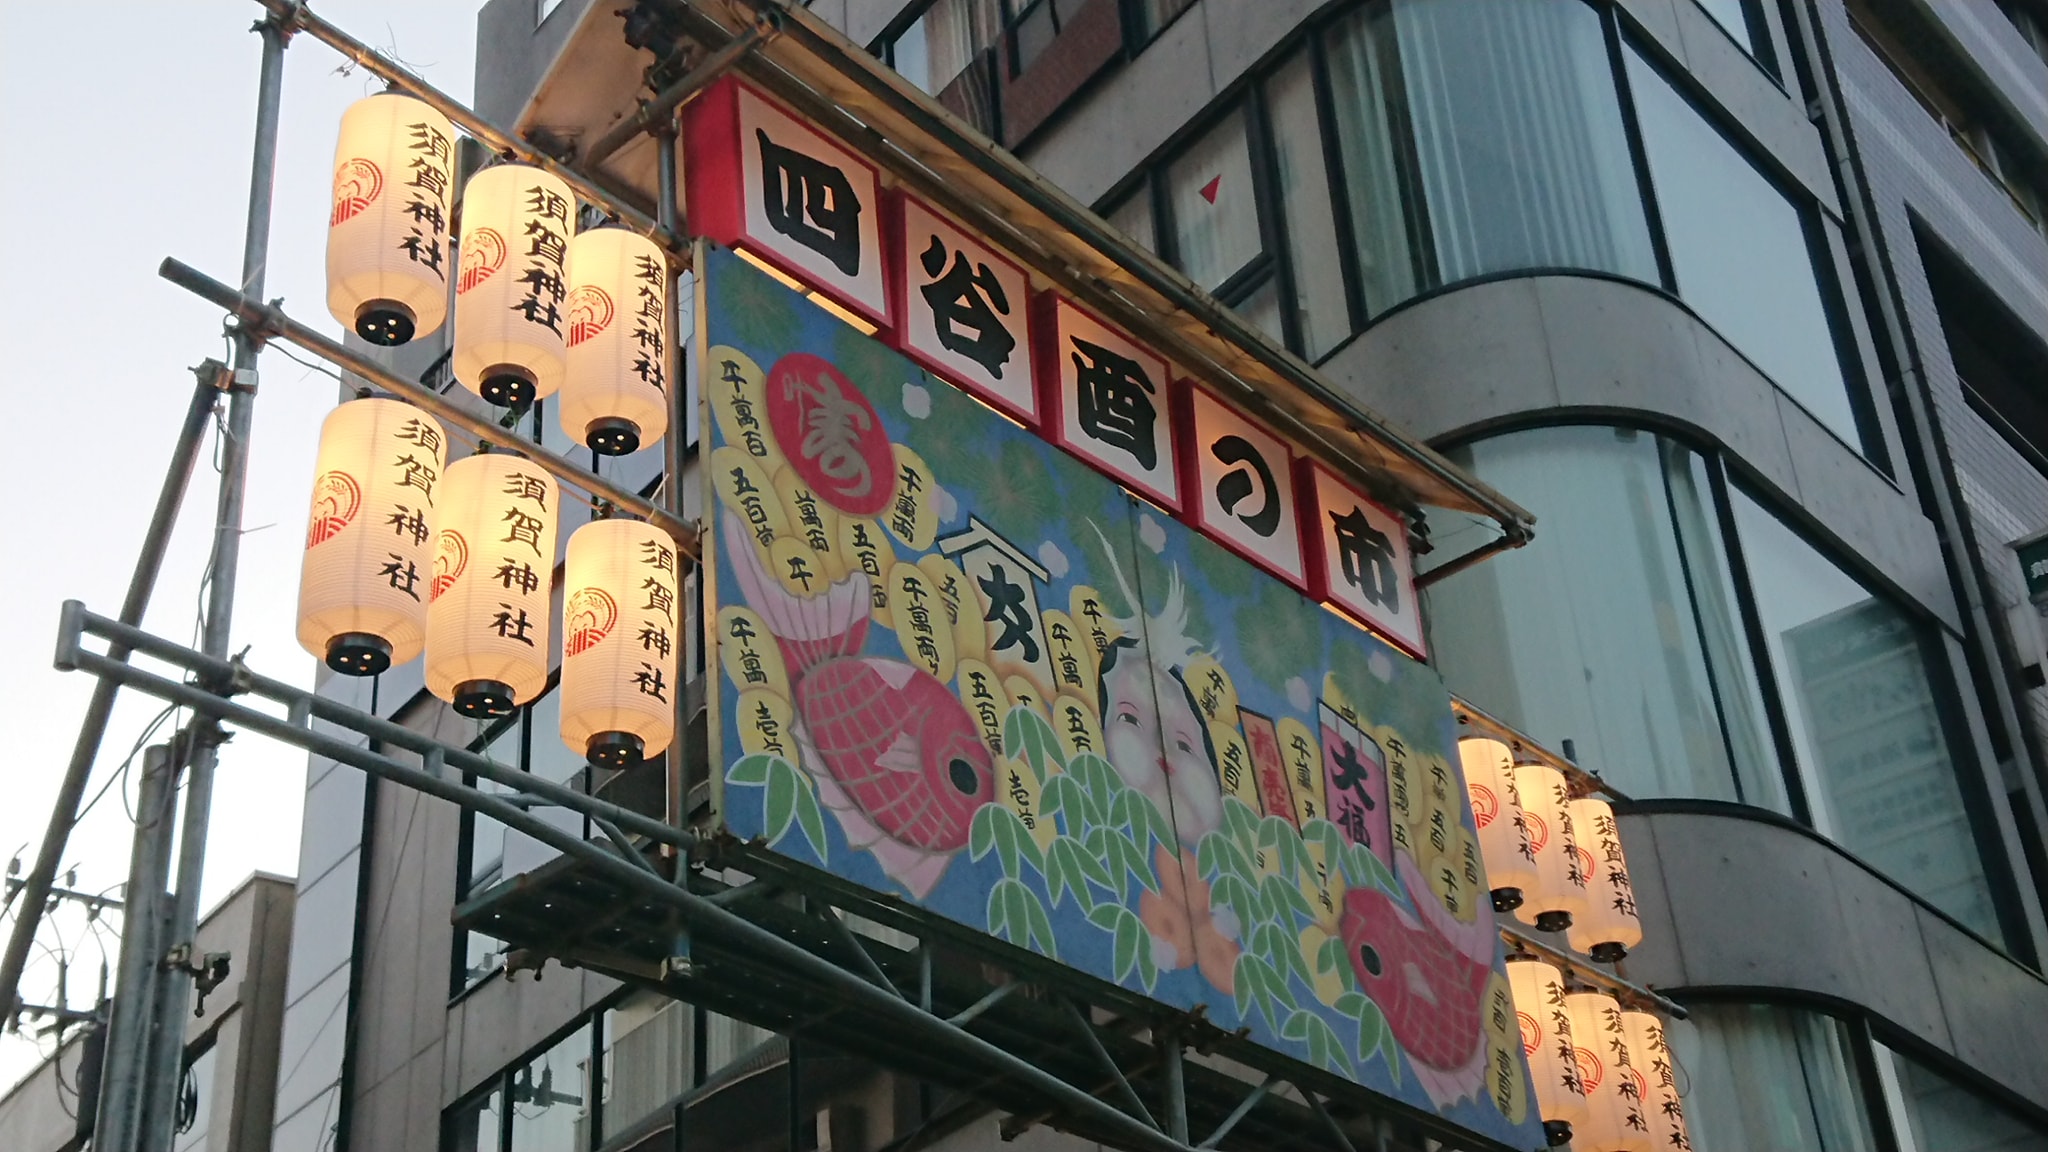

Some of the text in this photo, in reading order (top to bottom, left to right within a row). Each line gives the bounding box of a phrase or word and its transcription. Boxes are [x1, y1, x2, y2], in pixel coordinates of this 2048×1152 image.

[398, 122, 451, 284] 須賀神社
[510, 185, 571, 342] 須賀神社
[631, 253, 666, 393] 須賀神社
[376, 417, 443, 604] 須賀神社
[488, 471, 548, 648] 須賀神社
[629, 538, 677, 705] 須賀神社
[1593, 814, 1640, 920] 須賀神社
